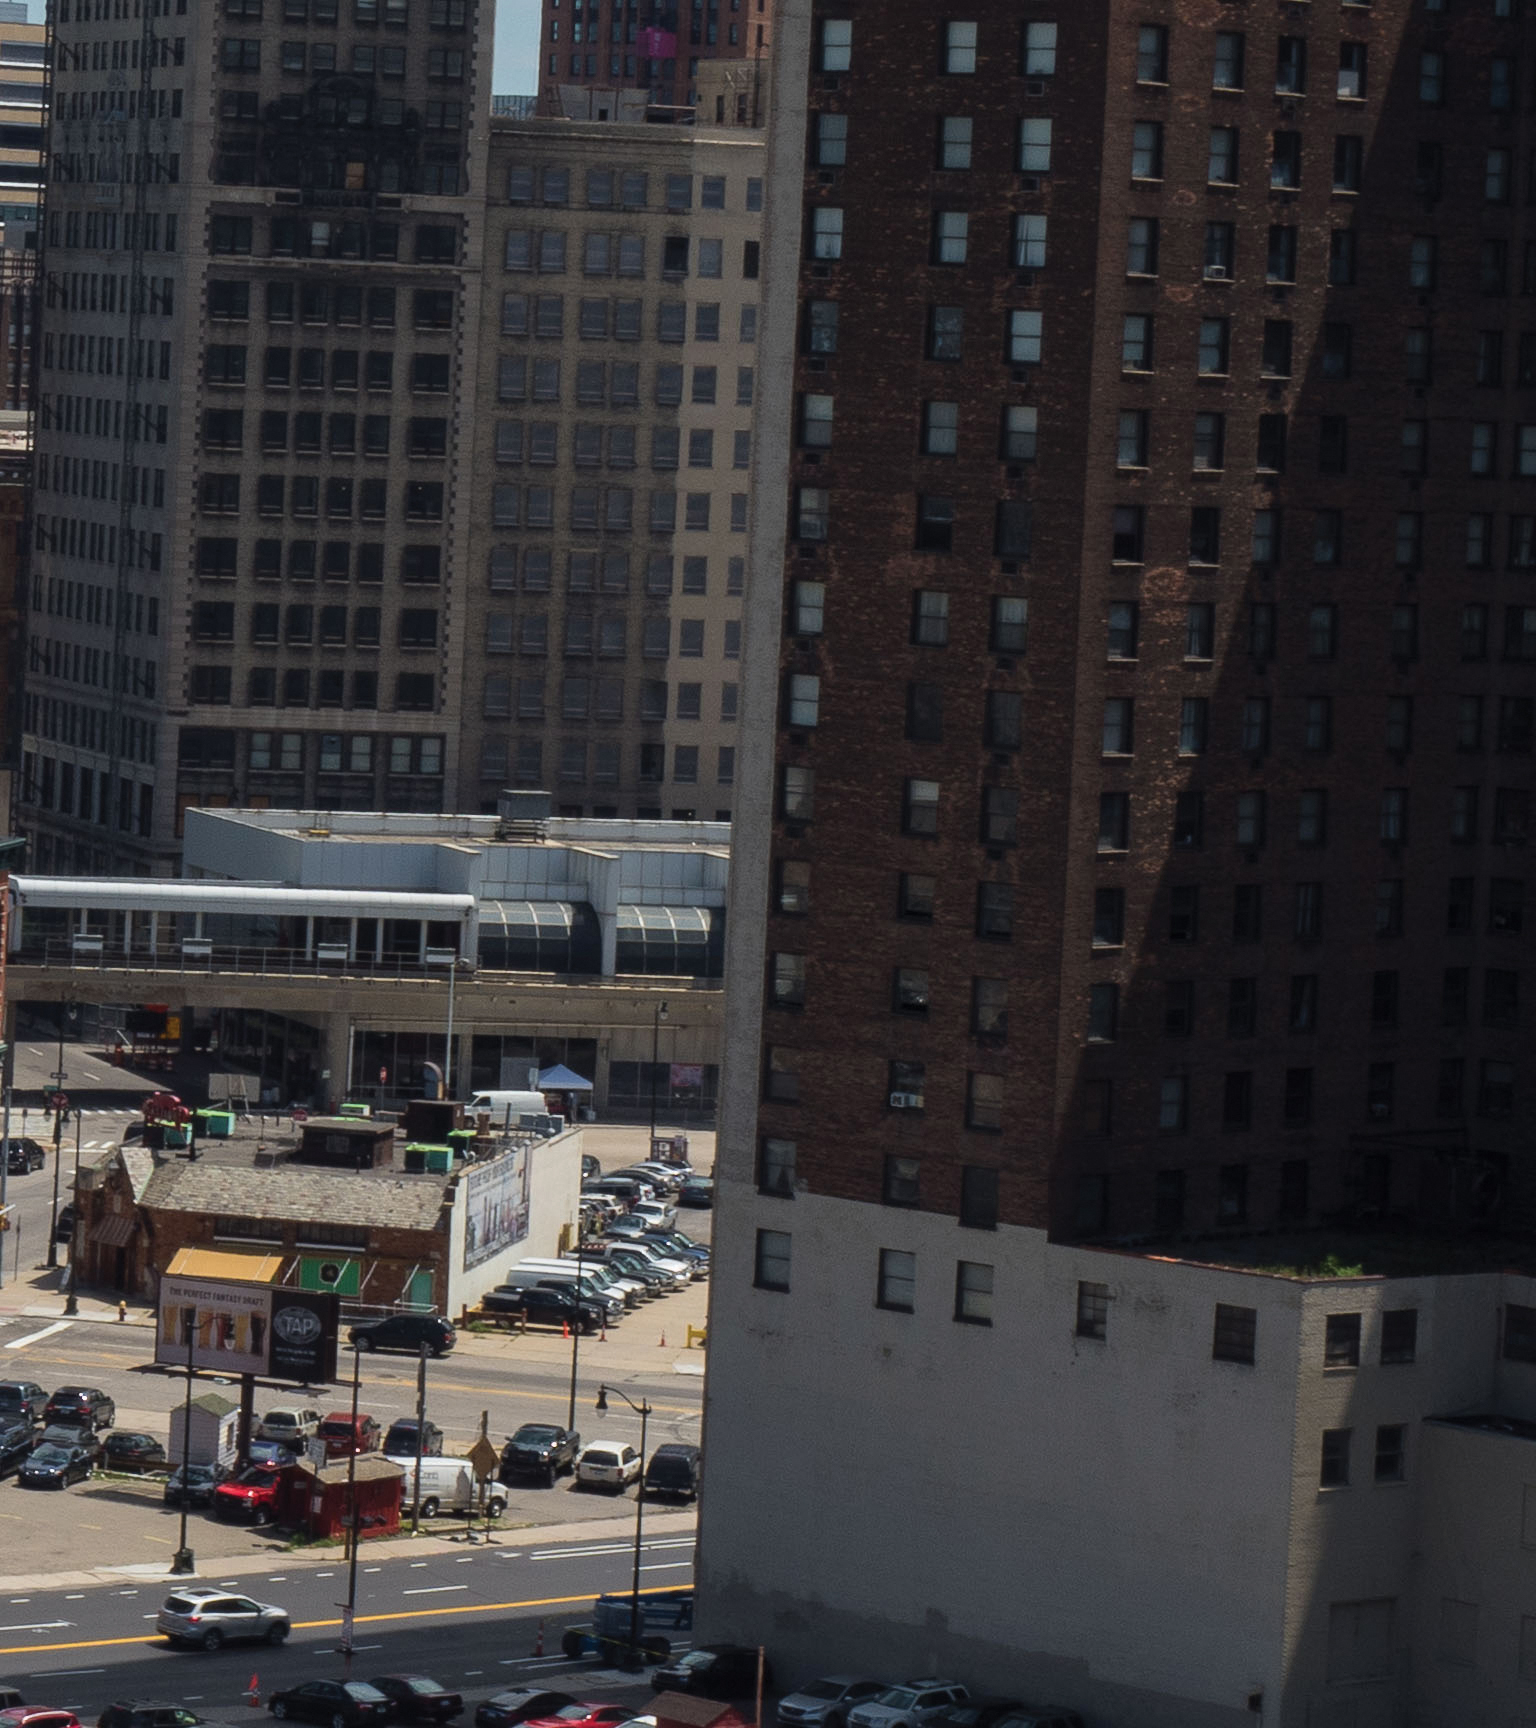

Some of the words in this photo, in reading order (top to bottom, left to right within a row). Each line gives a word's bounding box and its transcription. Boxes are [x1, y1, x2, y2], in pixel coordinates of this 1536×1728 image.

[169, 1286, 182, 1296] THE
[183, 1288, 211, 1300] PERFECT
[212, 1292, 241, 1303] FANTASY
[242, 1296, 264, 1306] DRAFT
[284, 1316, 314, 1335] TAP
